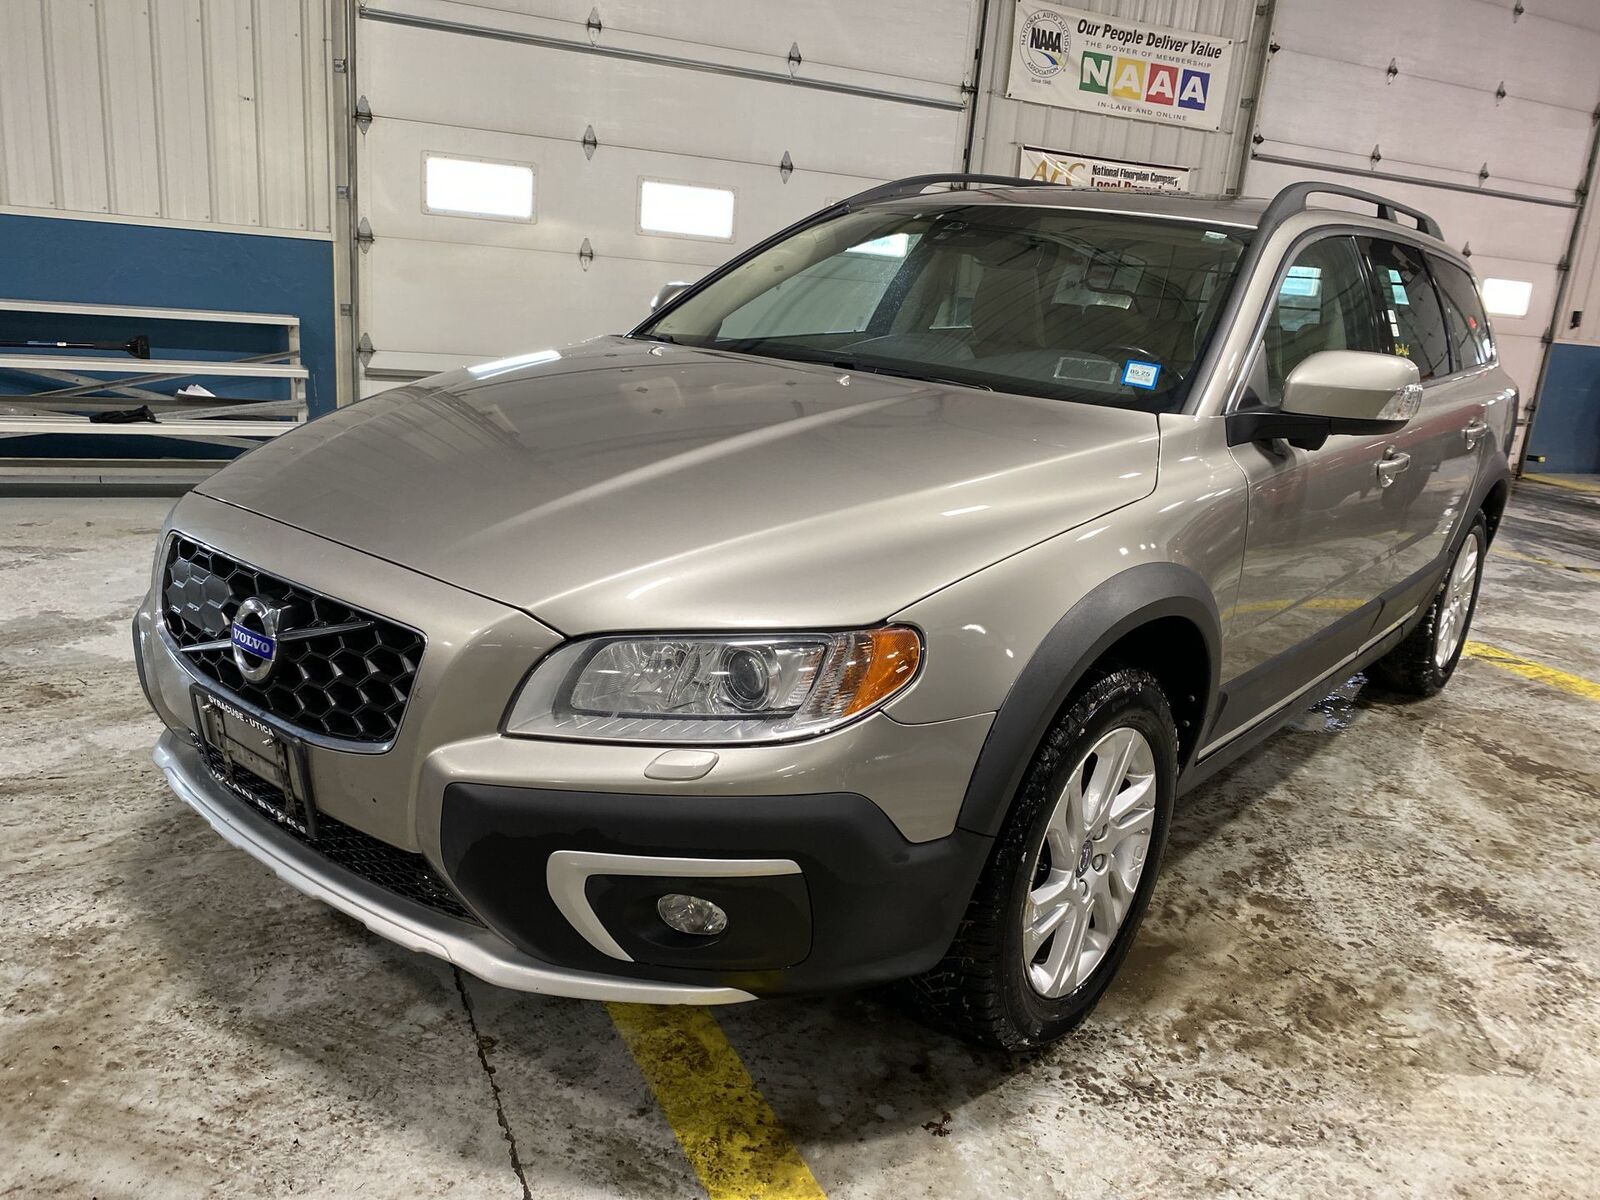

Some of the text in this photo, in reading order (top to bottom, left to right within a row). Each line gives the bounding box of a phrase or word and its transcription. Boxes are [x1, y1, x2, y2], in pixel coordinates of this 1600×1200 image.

[1022, 12, 1069, 53] NATIONAL AUTO AUCTION
[1030, 27, 1062, 53] NAAA
[1077, 19, 1222, 59] Our People Deliver Value
[1085, 40, 1212, 68] THE POWER OF MEMBERSHIP
[1027, 61, 1060, 76] ASSOCIATION
[1097, 101, 1188, 121] IN-LANE AND ONLINE
[1092, 165, 1119, 177] National
[1120, 168, 1150, 181] Floorplan
[233, 627, 270, 653] VOLVO
[207, 694, 275, 738] SYRACUSE UTICA
